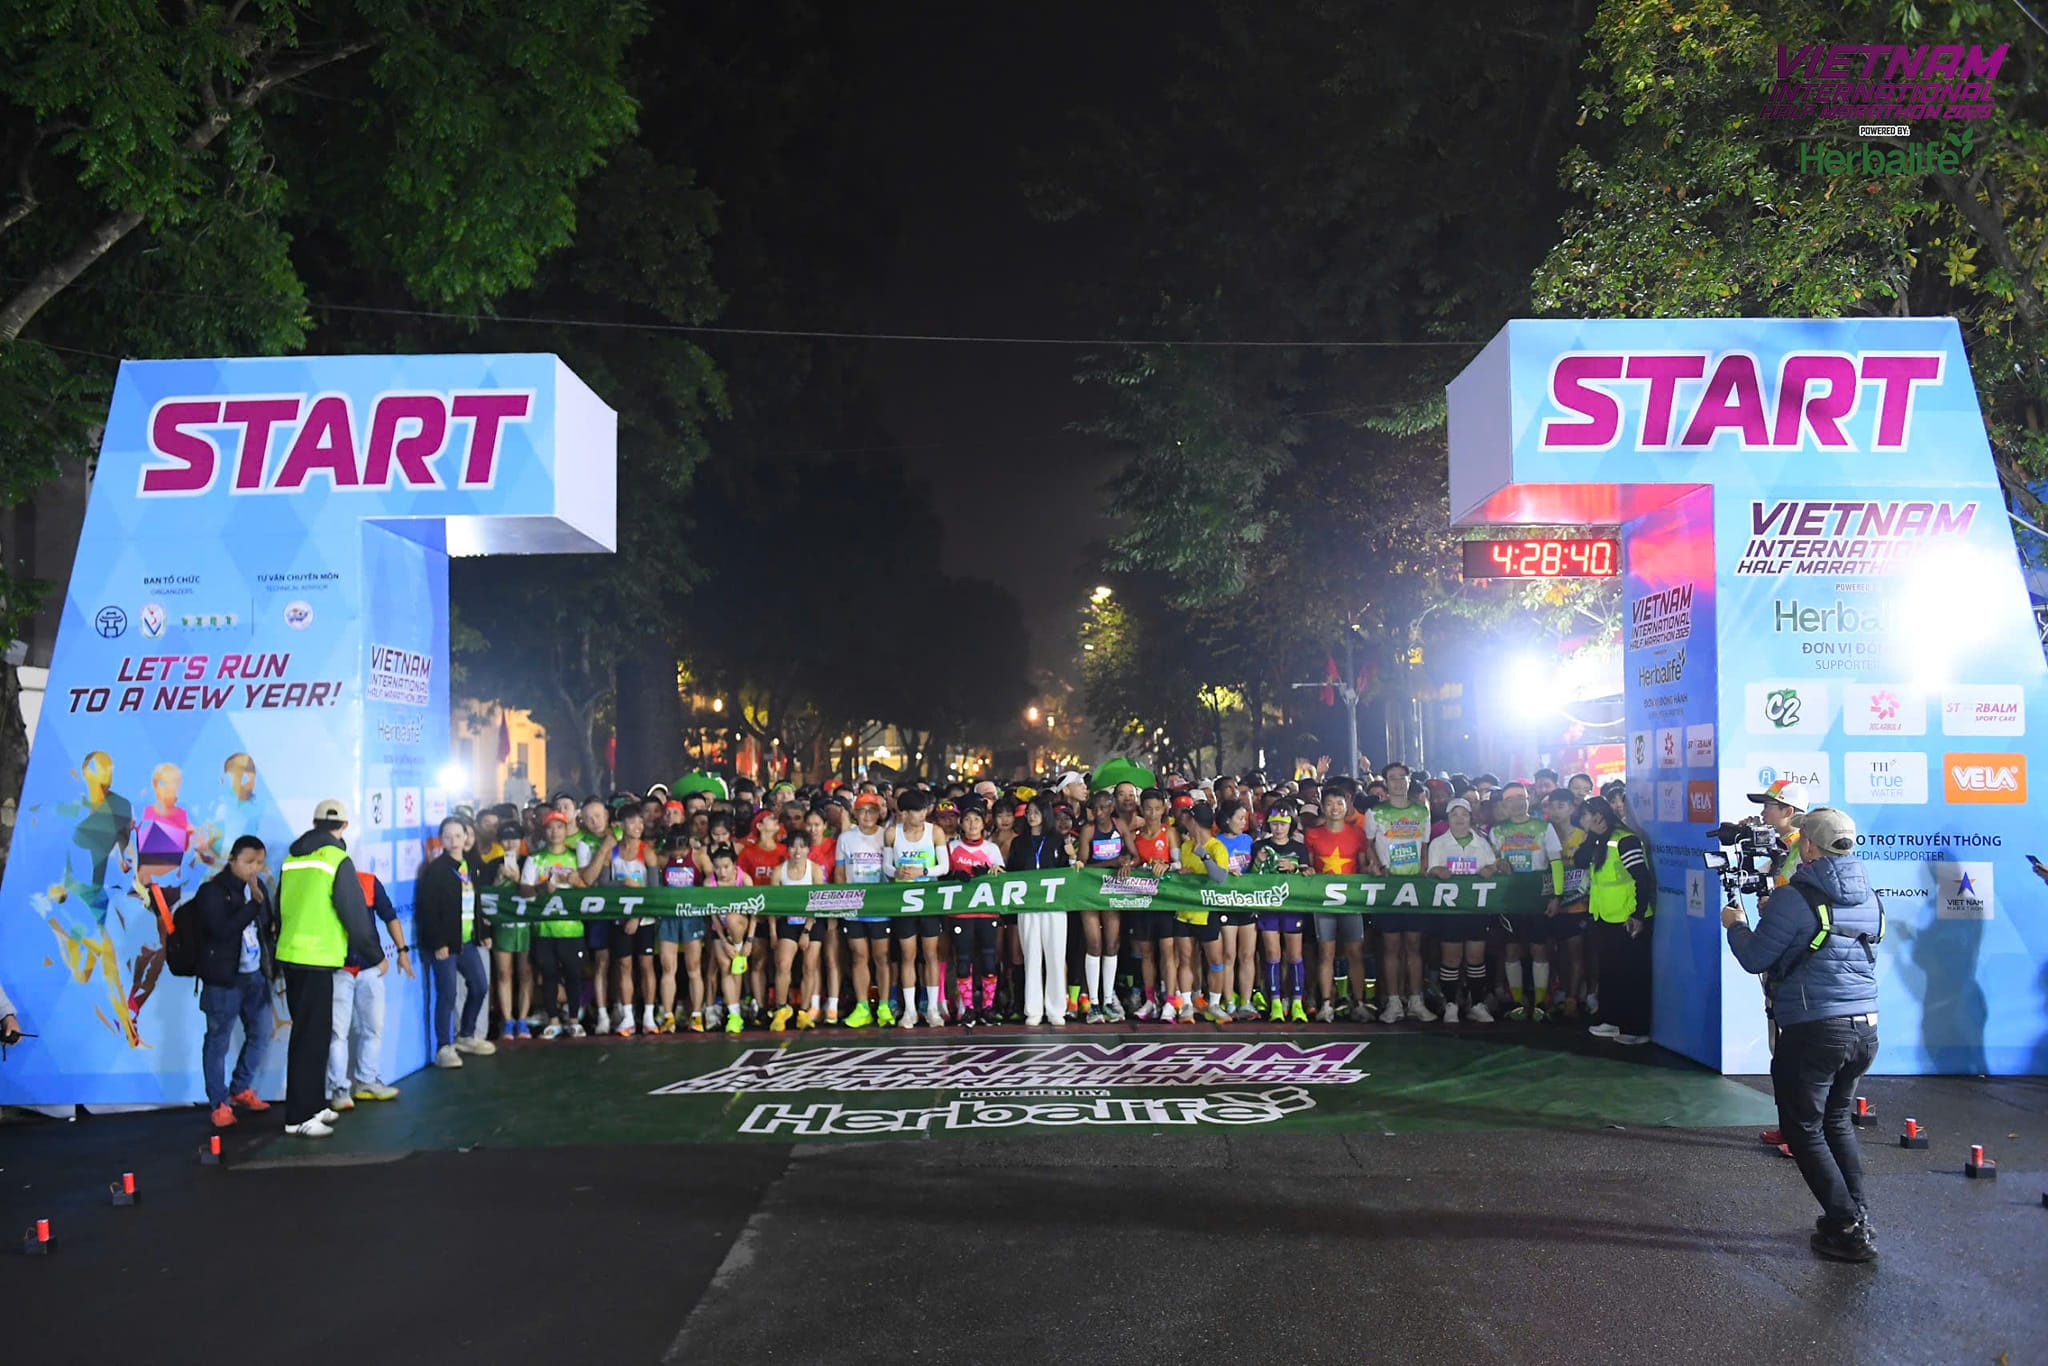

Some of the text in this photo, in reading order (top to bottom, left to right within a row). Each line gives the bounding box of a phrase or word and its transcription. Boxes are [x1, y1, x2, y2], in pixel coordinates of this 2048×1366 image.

[1541, 352, 1943, 450] START
[140, 391, 533, 494] START
[1753, 502, 1977, 536] VIETNAM
[1746, 540, 1918, 558] INTERNATIO
[1737, 560, 1895, 574] HALF MARATH
[1632, 583, 1693, 624] VIETNAM
[1775, 600, 1885, 633] Herba
[1631, 611, 1690, 639] INTERNATIONAL
[117, 653, 291, 682] LET'S RUN
[371, 645, 431, 679] VIETNAM
[69, 681, 342, 713] TO A NEW YEAR!
[1765, 692, 1801, 727] C2
[1870, 774, 1903, 788] true
[1952, 766, 2018, 791] VELA
[1870, 788, 1903, 798] WATER
[1870, 834, 1896, 849] TRỢ
[1952, 833, 2002, 847] THÔNG
[1884, 850, 1945, 862] SUPPORTER
[809, 889, 865, 900] VIETNAM
[901, 877, 1066, 912] START
[1201, 888, 1283, 907] Herbalife
[1323, 882, 1497, 908] START
[736, 1043, 1362, 1066] VIETNAM
[960, 1089, 1072, 1099] POWERED
[738, 1098, 1285, 1135] Herbalife
